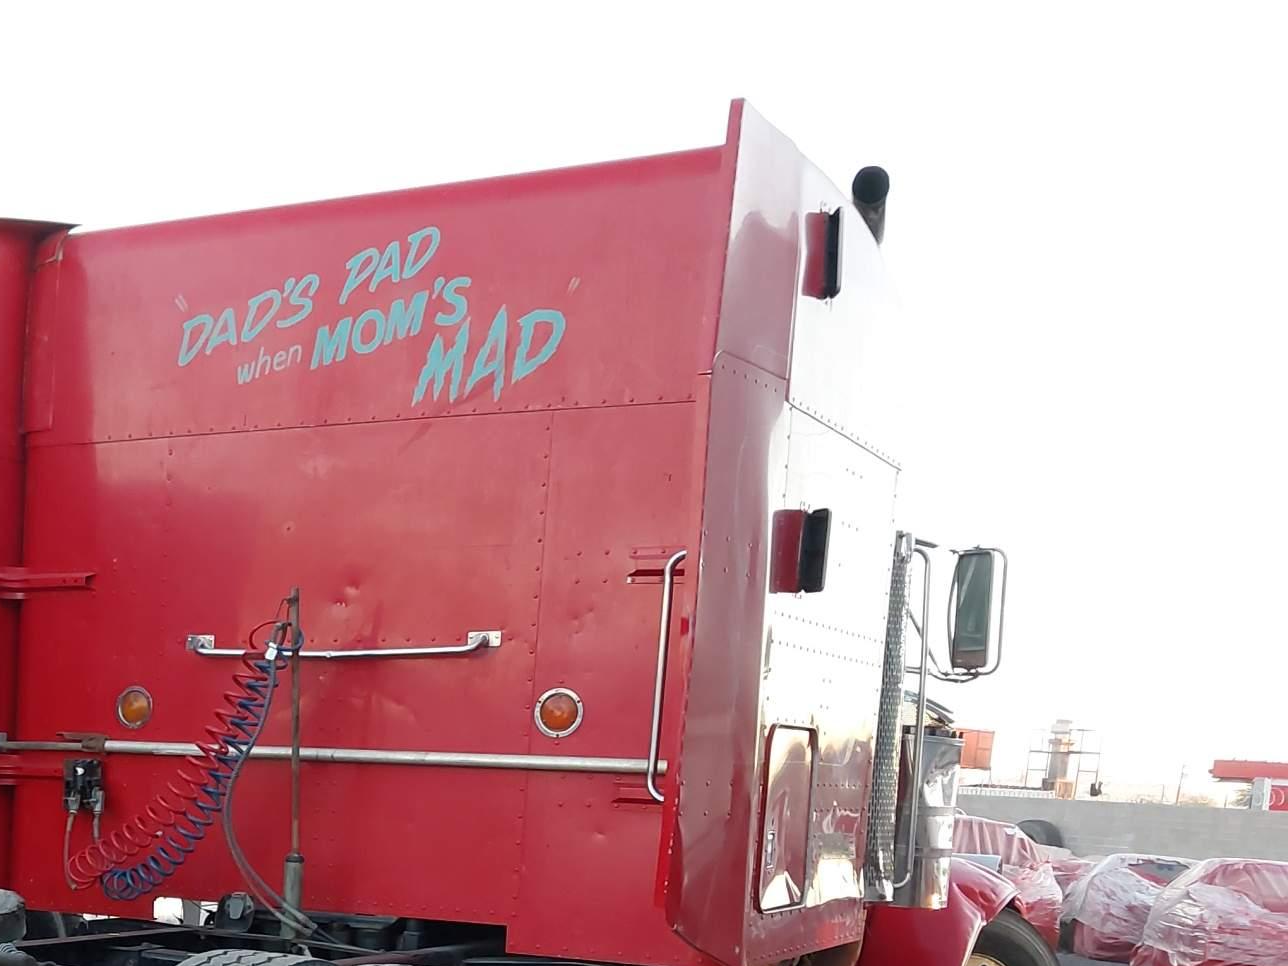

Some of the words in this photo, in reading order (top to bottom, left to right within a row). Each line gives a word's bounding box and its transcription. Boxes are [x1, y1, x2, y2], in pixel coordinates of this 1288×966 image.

[339, 226, 440, 304] PAD
[237, 342, 302, 384] when
[311, 276, 471, 370] MOM'S
